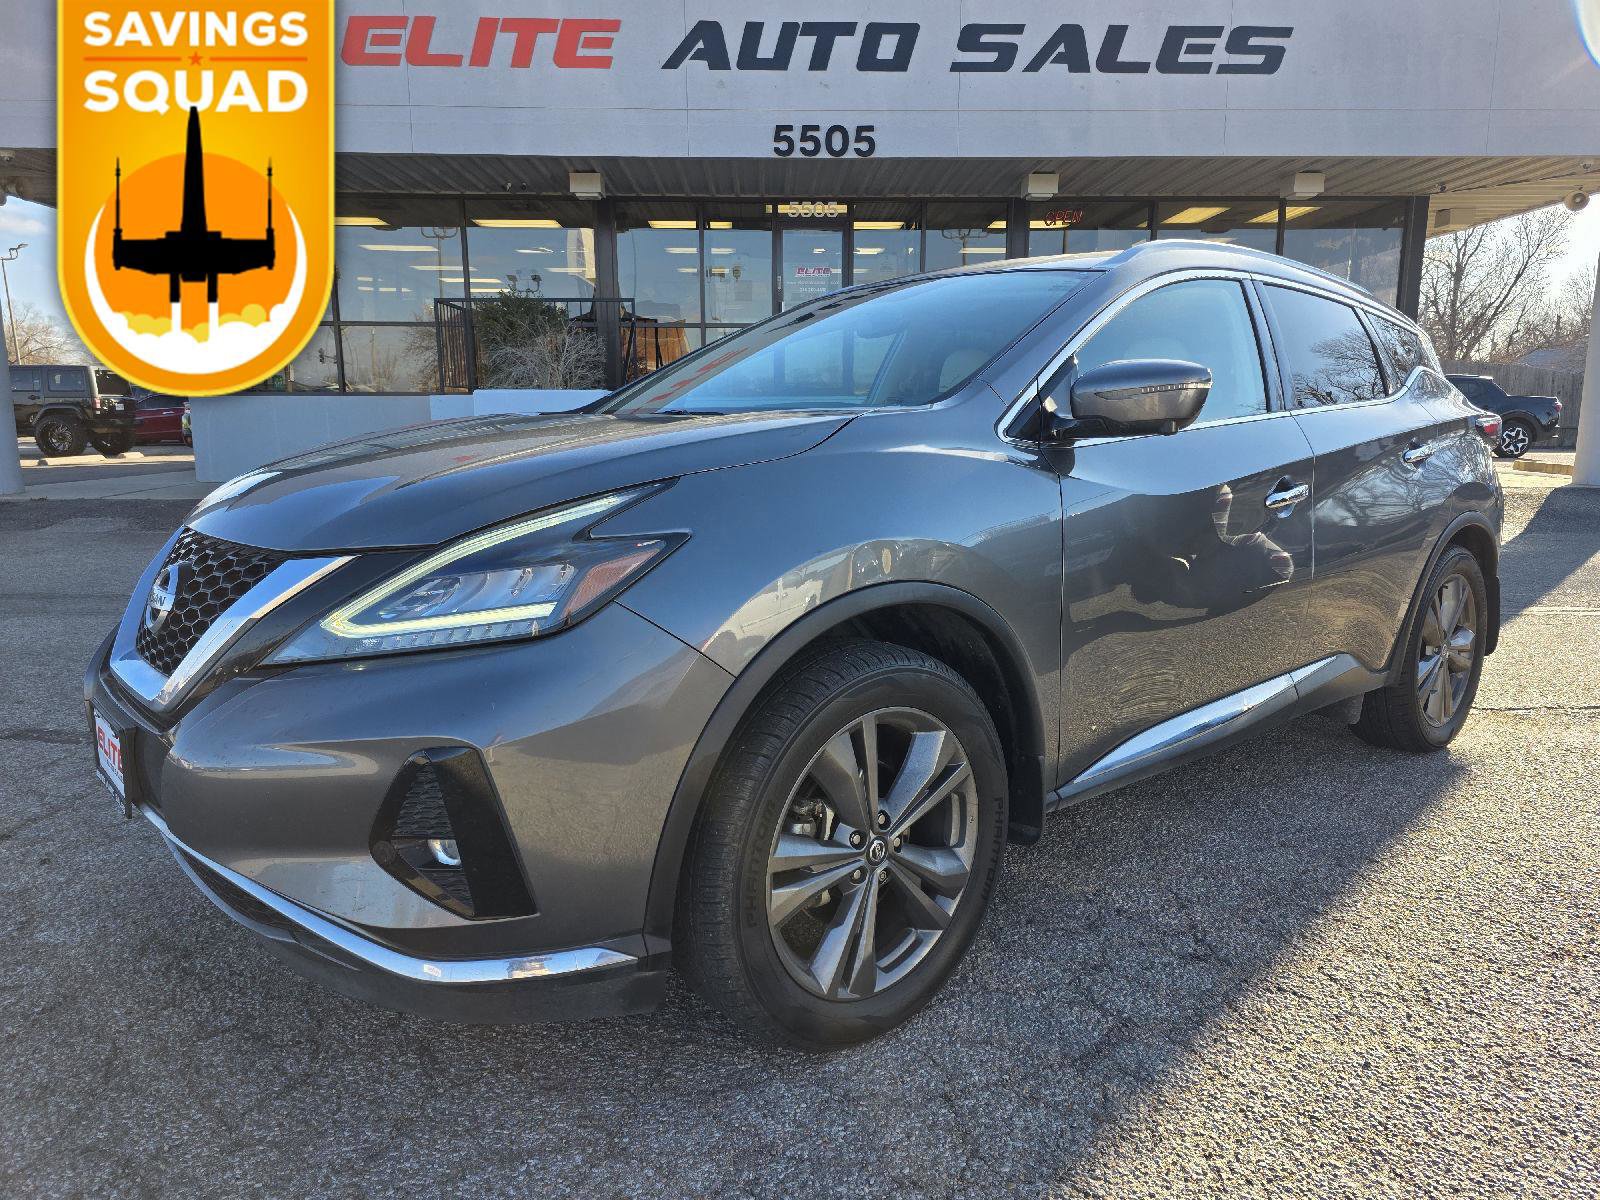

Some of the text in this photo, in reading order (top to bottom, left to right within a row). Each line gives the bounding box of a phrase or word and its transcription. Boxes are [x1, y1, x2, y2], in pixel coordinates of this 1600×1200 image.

[341, 15, 1294, 75] ELITE AUTO SALES
[773, 125, 877, 158] 5505
[788, 202, 839, 218] 5505
[1044, 209, 1084, 226] OPEN
